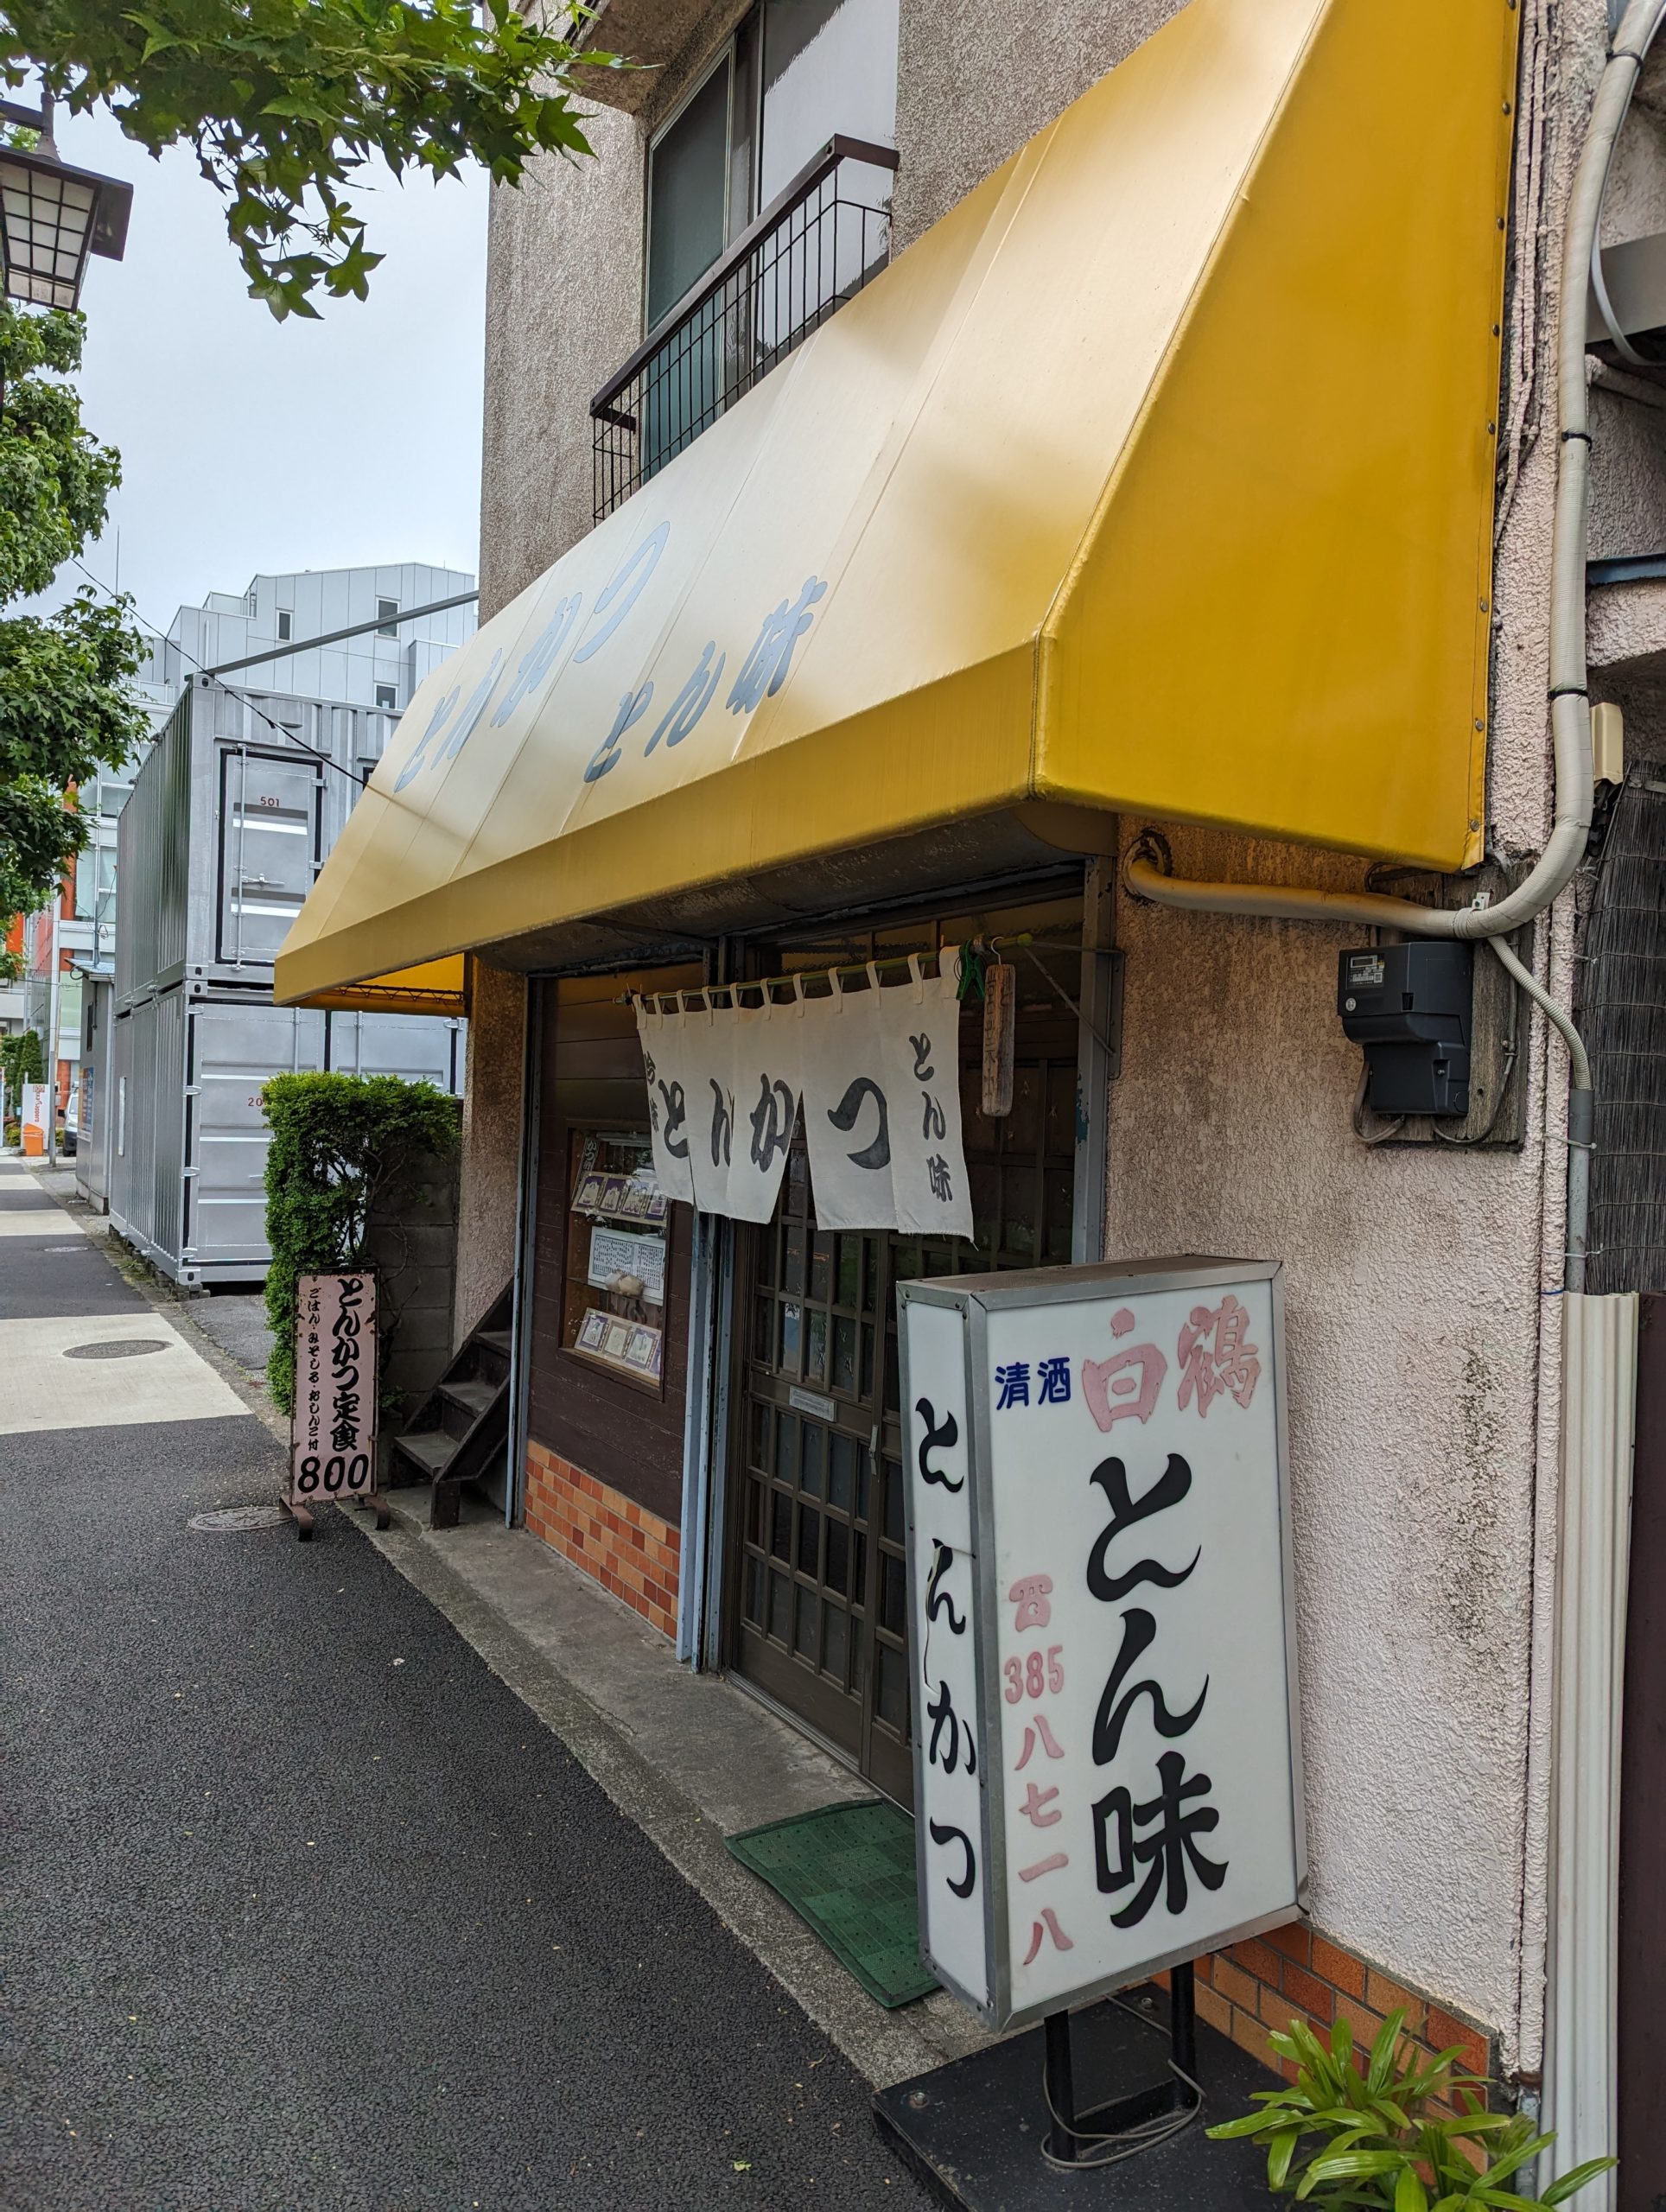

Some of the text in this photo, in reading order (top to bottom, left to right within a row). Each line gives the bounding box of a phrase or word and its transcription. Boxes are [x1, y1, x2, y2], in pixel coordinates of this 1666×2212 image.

[393, 520, 671, 793] とんかつ
[583, 575, 828, 783] とん味
[260, 796, 280, 808] 501
[658, 1073, 891, 1173] とんかつ
[908, 1033, 953, 1202] とん味
[329, 1278, 364, 1452] とんかつ定食
[995, 1294, 1262, 1433] 清酒 白鶴
[297, 1453, 369, 1493] 800
[914, 1397, 976, 1900] とんかつ
[1086, 1453, 1230, 1929] とん味
